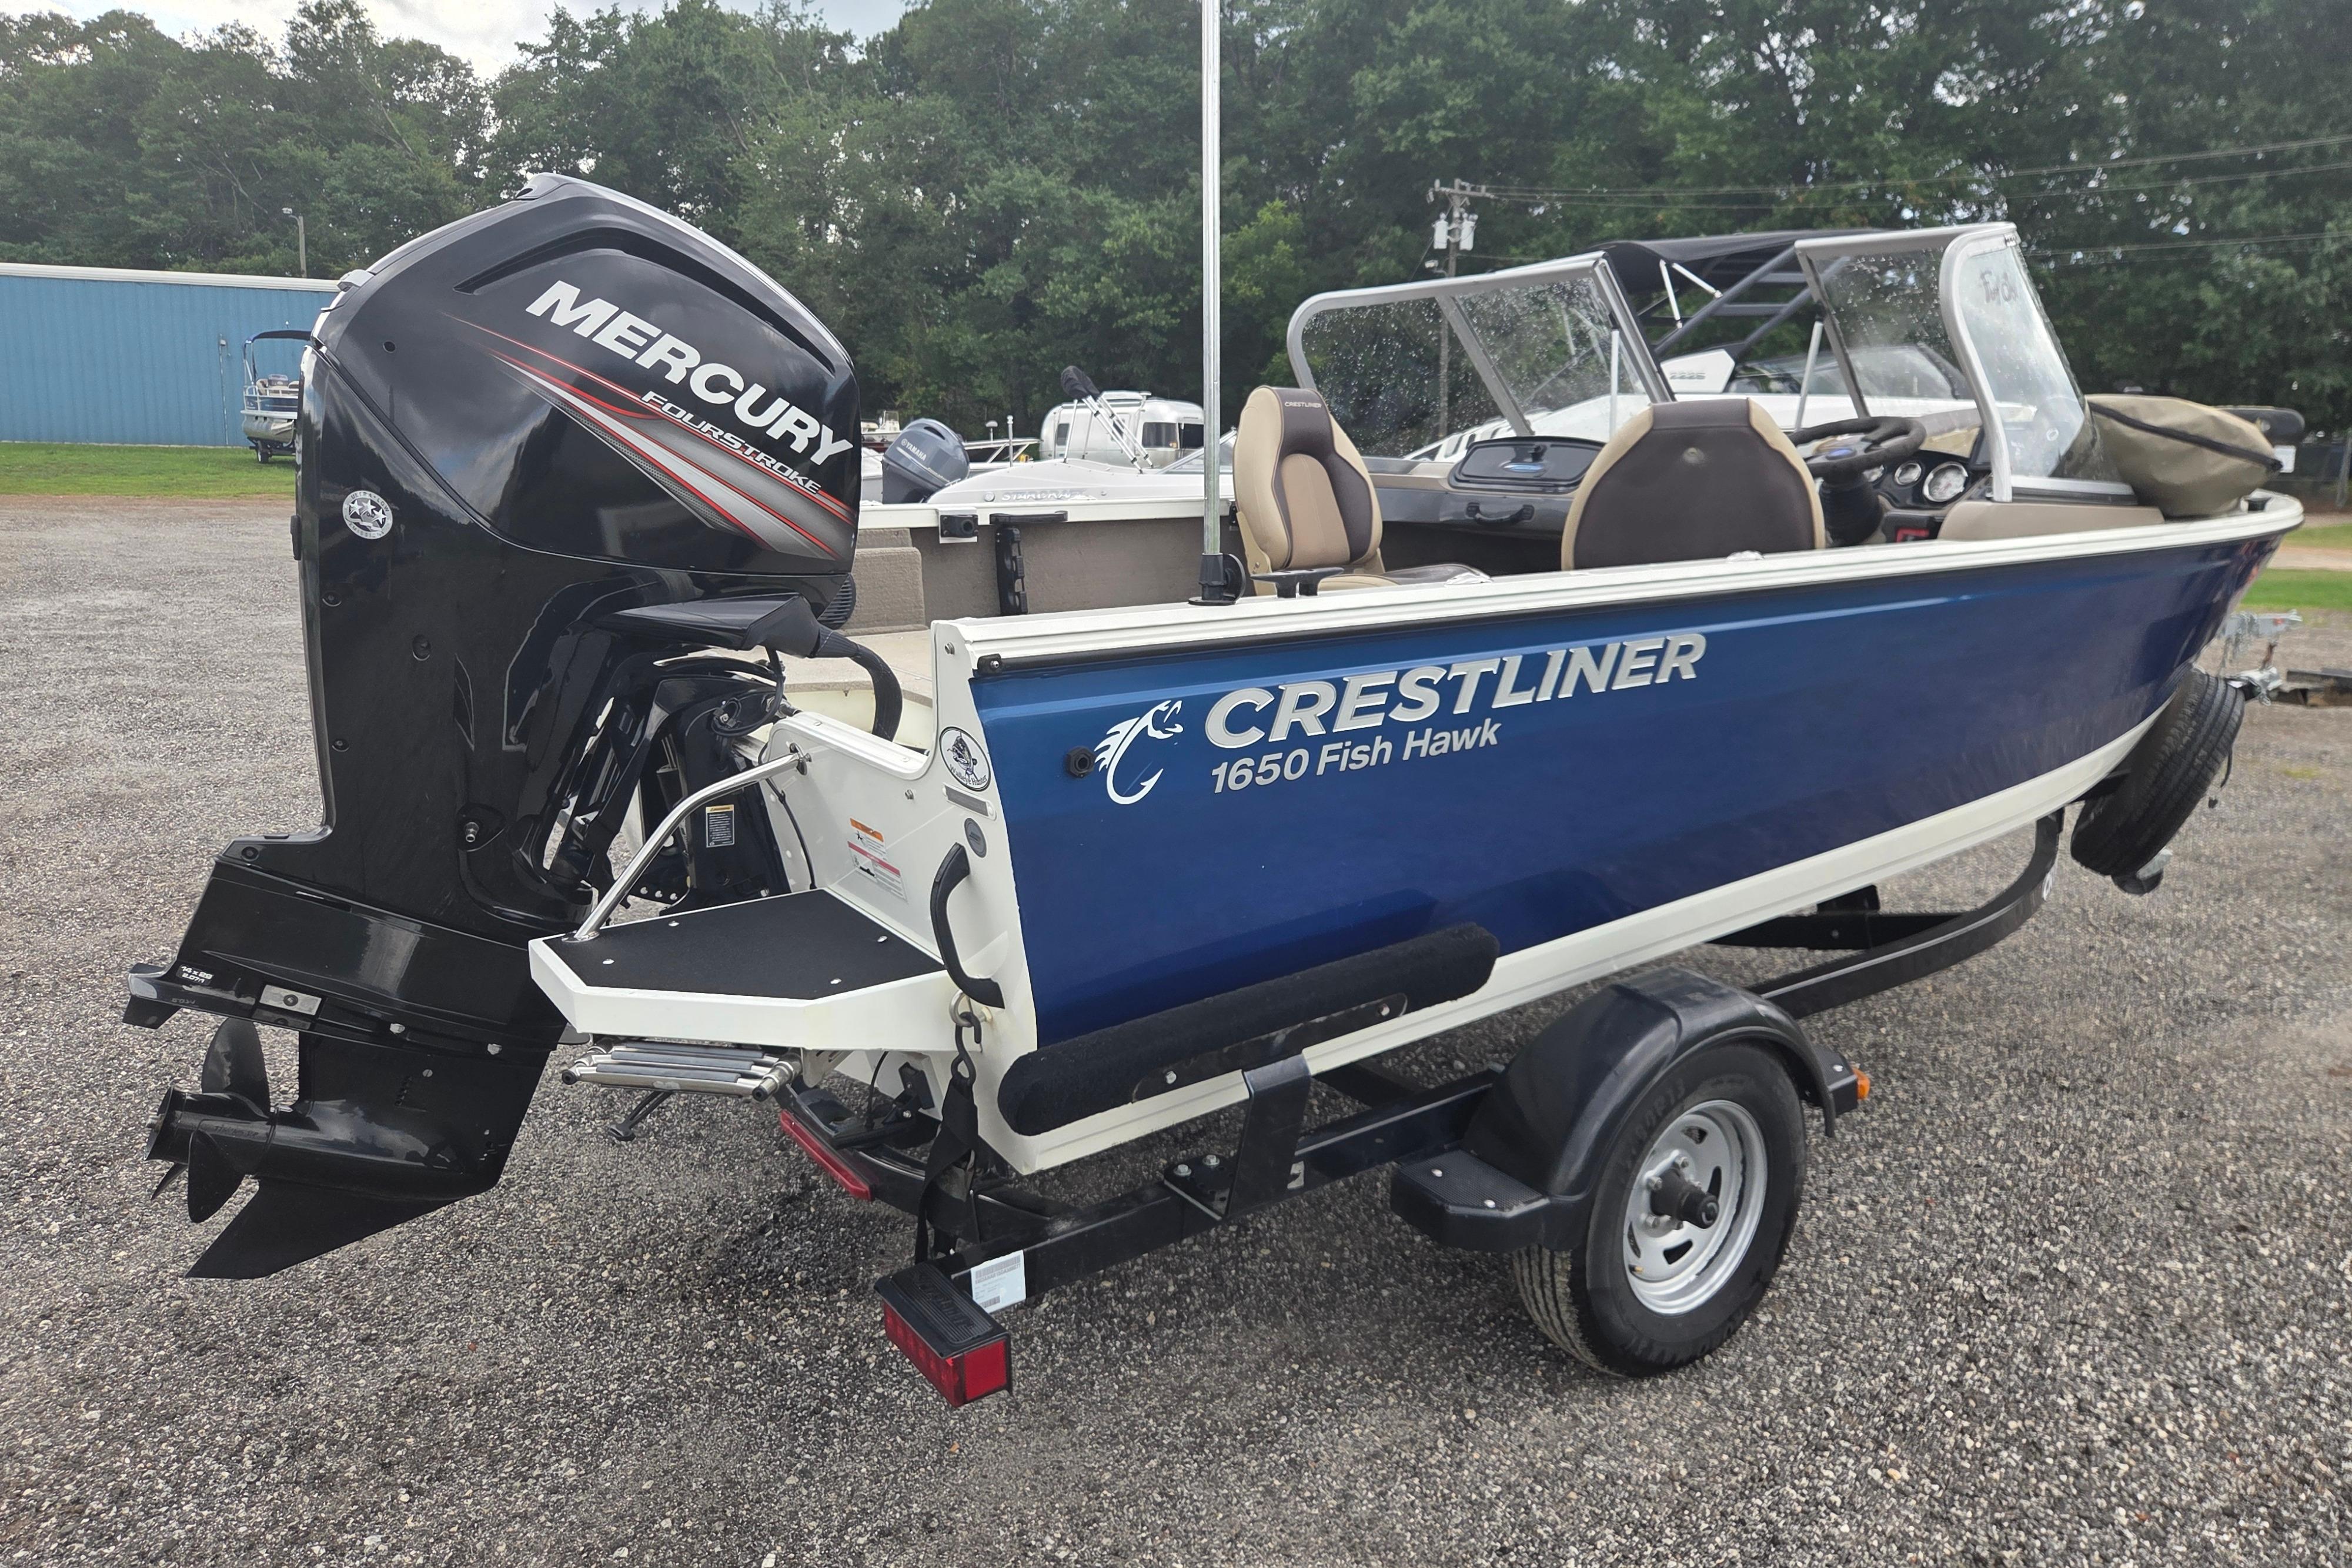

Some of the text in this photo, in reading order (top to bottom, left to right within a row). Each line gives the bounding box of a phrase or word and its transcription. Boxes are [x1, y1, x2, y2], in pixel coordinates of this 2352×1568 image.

[526, 280, 854, 466] MERCURY
[640, 390, 822, 494] FOURSTROKE
[906, 442, 927, 462] YAMAHA
[1205, 633, 1707, 749] CRESTLINER
[971, 774, 988, 785] Hunter
[1211, 717, 1502, 794] 1650 Fish Hawk
